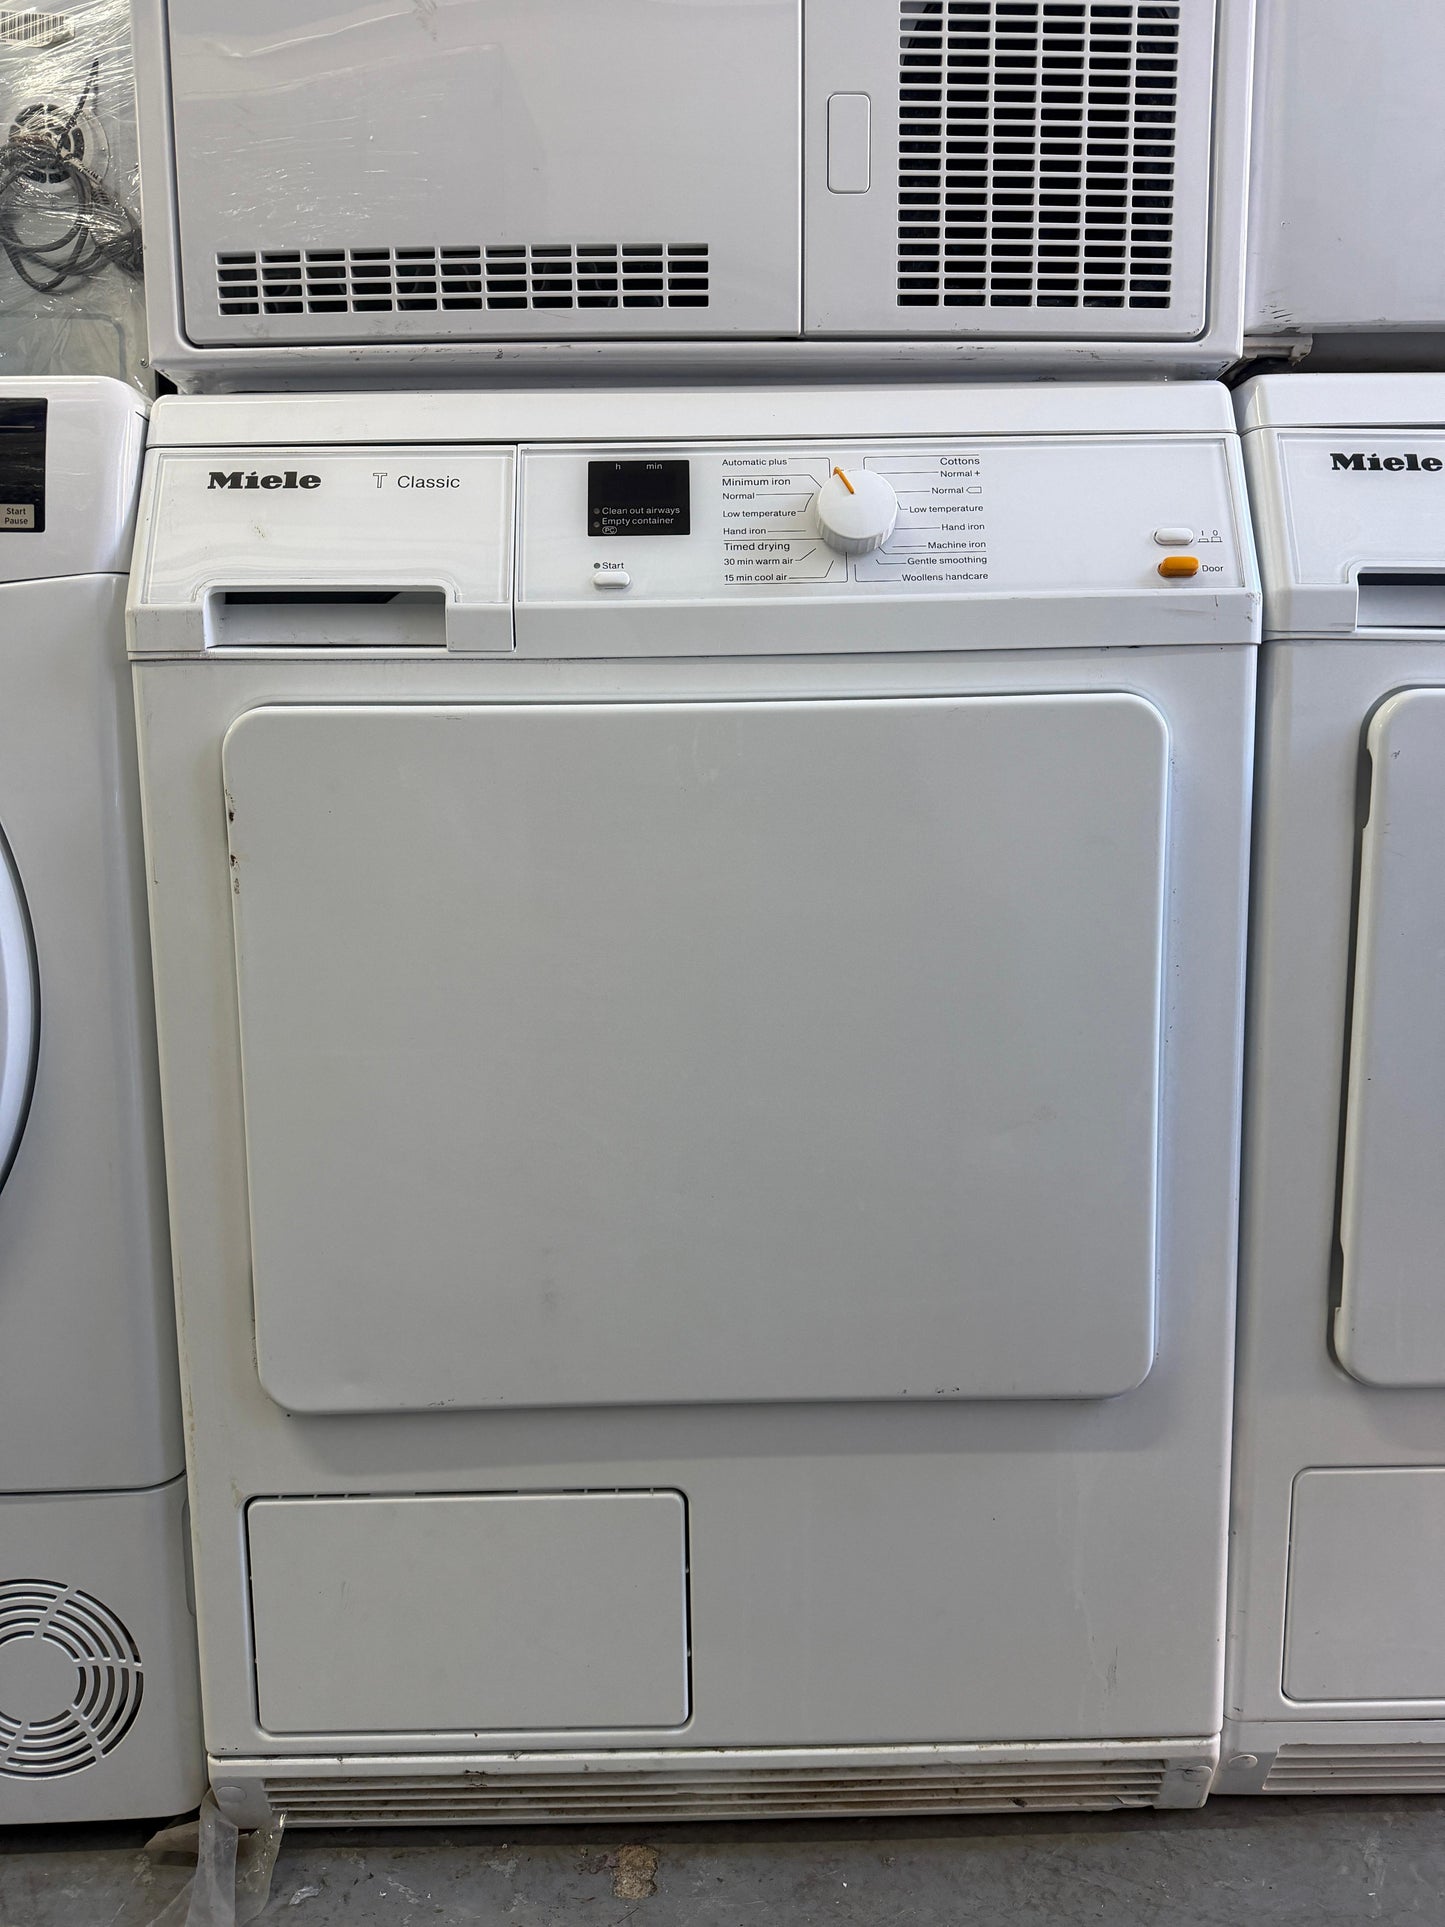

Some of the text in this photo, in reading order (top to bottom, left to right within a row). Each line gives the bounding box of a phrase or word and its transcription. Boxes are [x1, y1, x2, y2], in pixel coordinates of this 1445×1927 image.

[722, 458, 787, 466] Automatic plus
[940, 457, 980, 466] Cottons
[1330, 453, 1442, 471] Miele
[208, 471, 321, 489] Miele
[397, 474, 460, 488] Classic
[722, 478, 791, 486] Minimum iron
[646, 507, 680, 515] airways
[929, 505, 983, 513] temperature
[743, 510, 796, 518] temperature
[602, 517, 630, 526] Empty
[724, 542, 790, 552] Timed drying
[908, 556, 987, 565] Gentle smoothing
[902, 572, 988, 582] Woollens handcare
